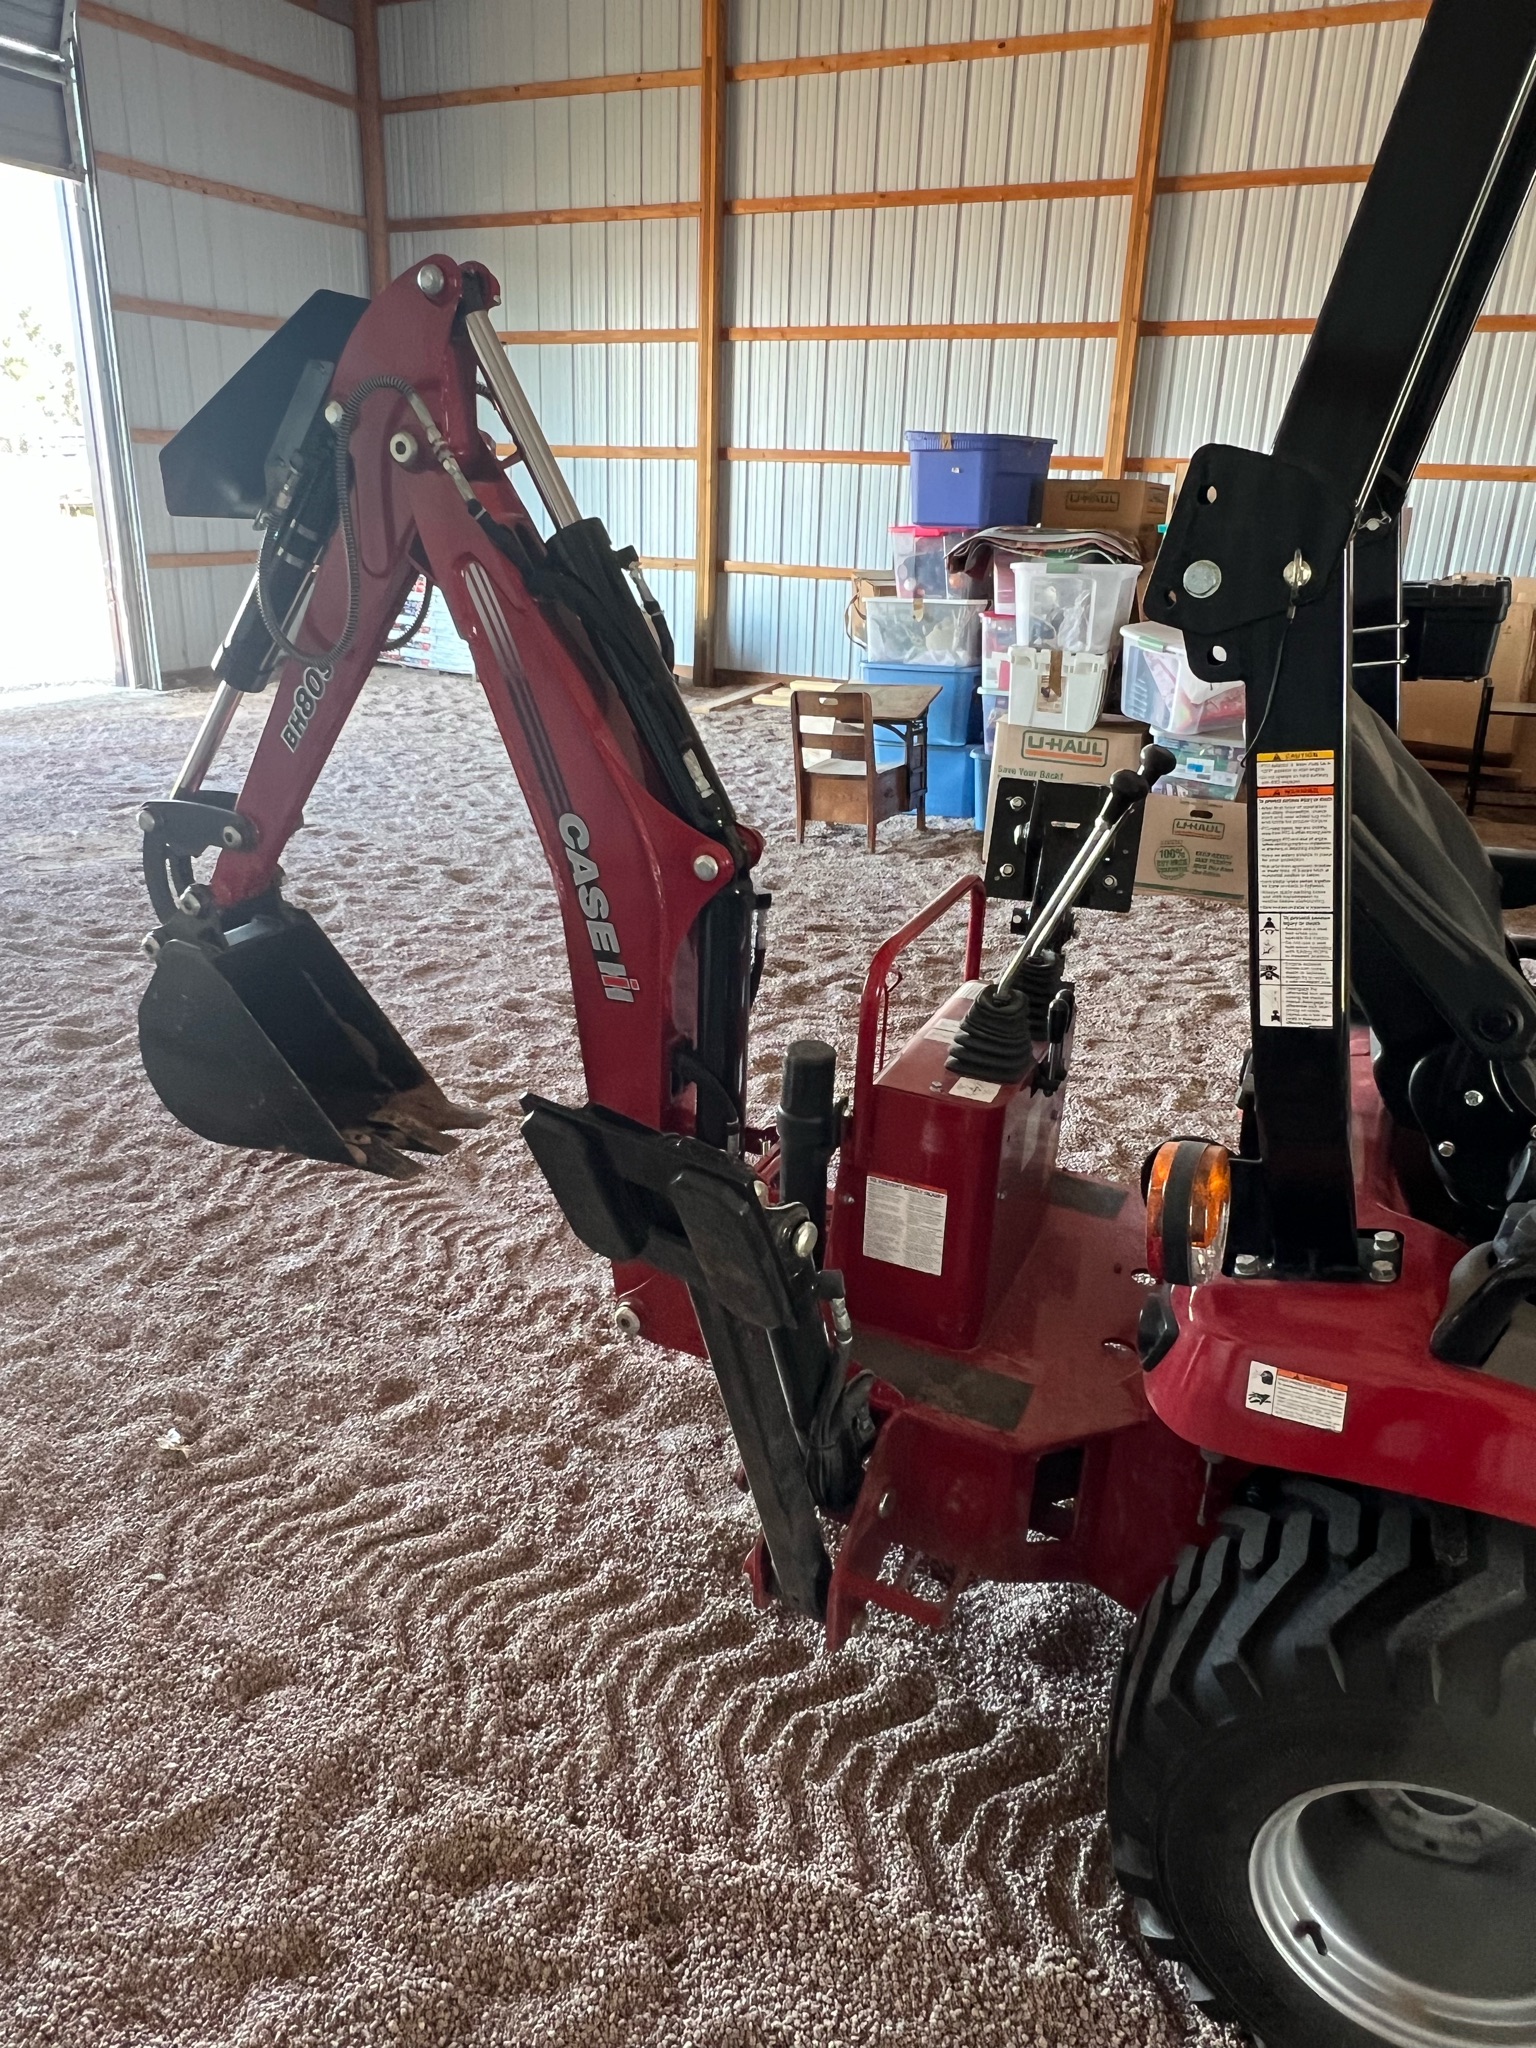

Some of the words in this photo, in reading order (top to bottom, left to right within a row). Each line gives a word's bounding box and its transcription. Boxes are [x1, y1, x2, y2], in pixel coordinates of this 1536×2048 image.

[1027, 735, 1103, 756] U-HAUL
[1285, 752, 1319, 760] CAUTION
[998, 765, 1017, 775] Save
[1019, 767, 1037, 778] Your
[1039, 770, 1064, 781] Back!
[1176, 821, 1222, 834] U-HAUL
[1159, 848, 1186, 859] 100%
[558, 812, 621, 954] CASE
